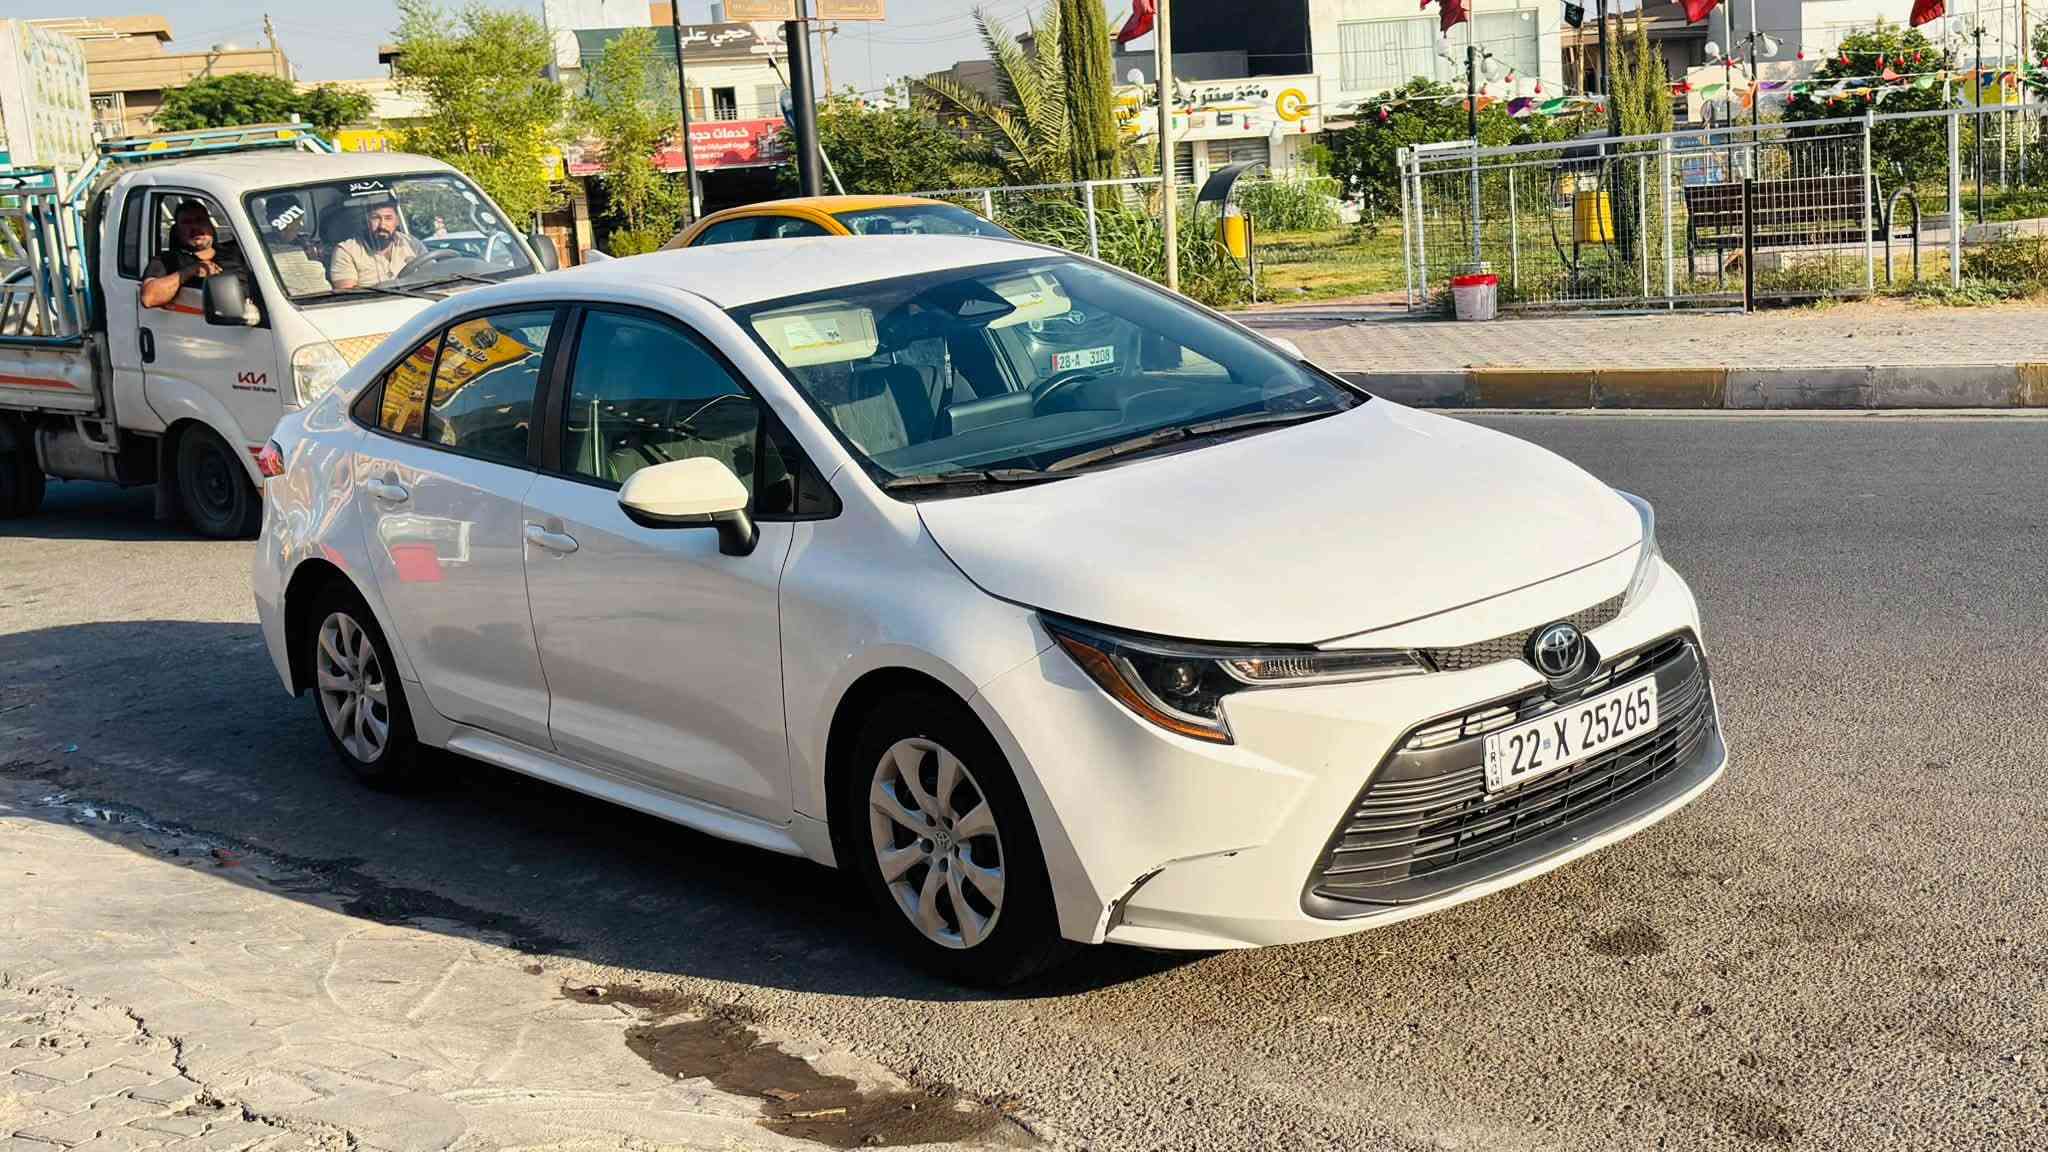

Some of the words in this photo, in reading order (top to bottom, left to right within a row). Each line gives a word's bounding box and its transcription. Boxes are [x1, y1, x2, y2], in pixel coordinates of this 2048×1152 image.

[238, 371, 267, 385] KIA
[1509, 728, 1543, 776] 22
[1554, 718, 1570, 761] X
[1580, 686, 1650, 751] 25265
